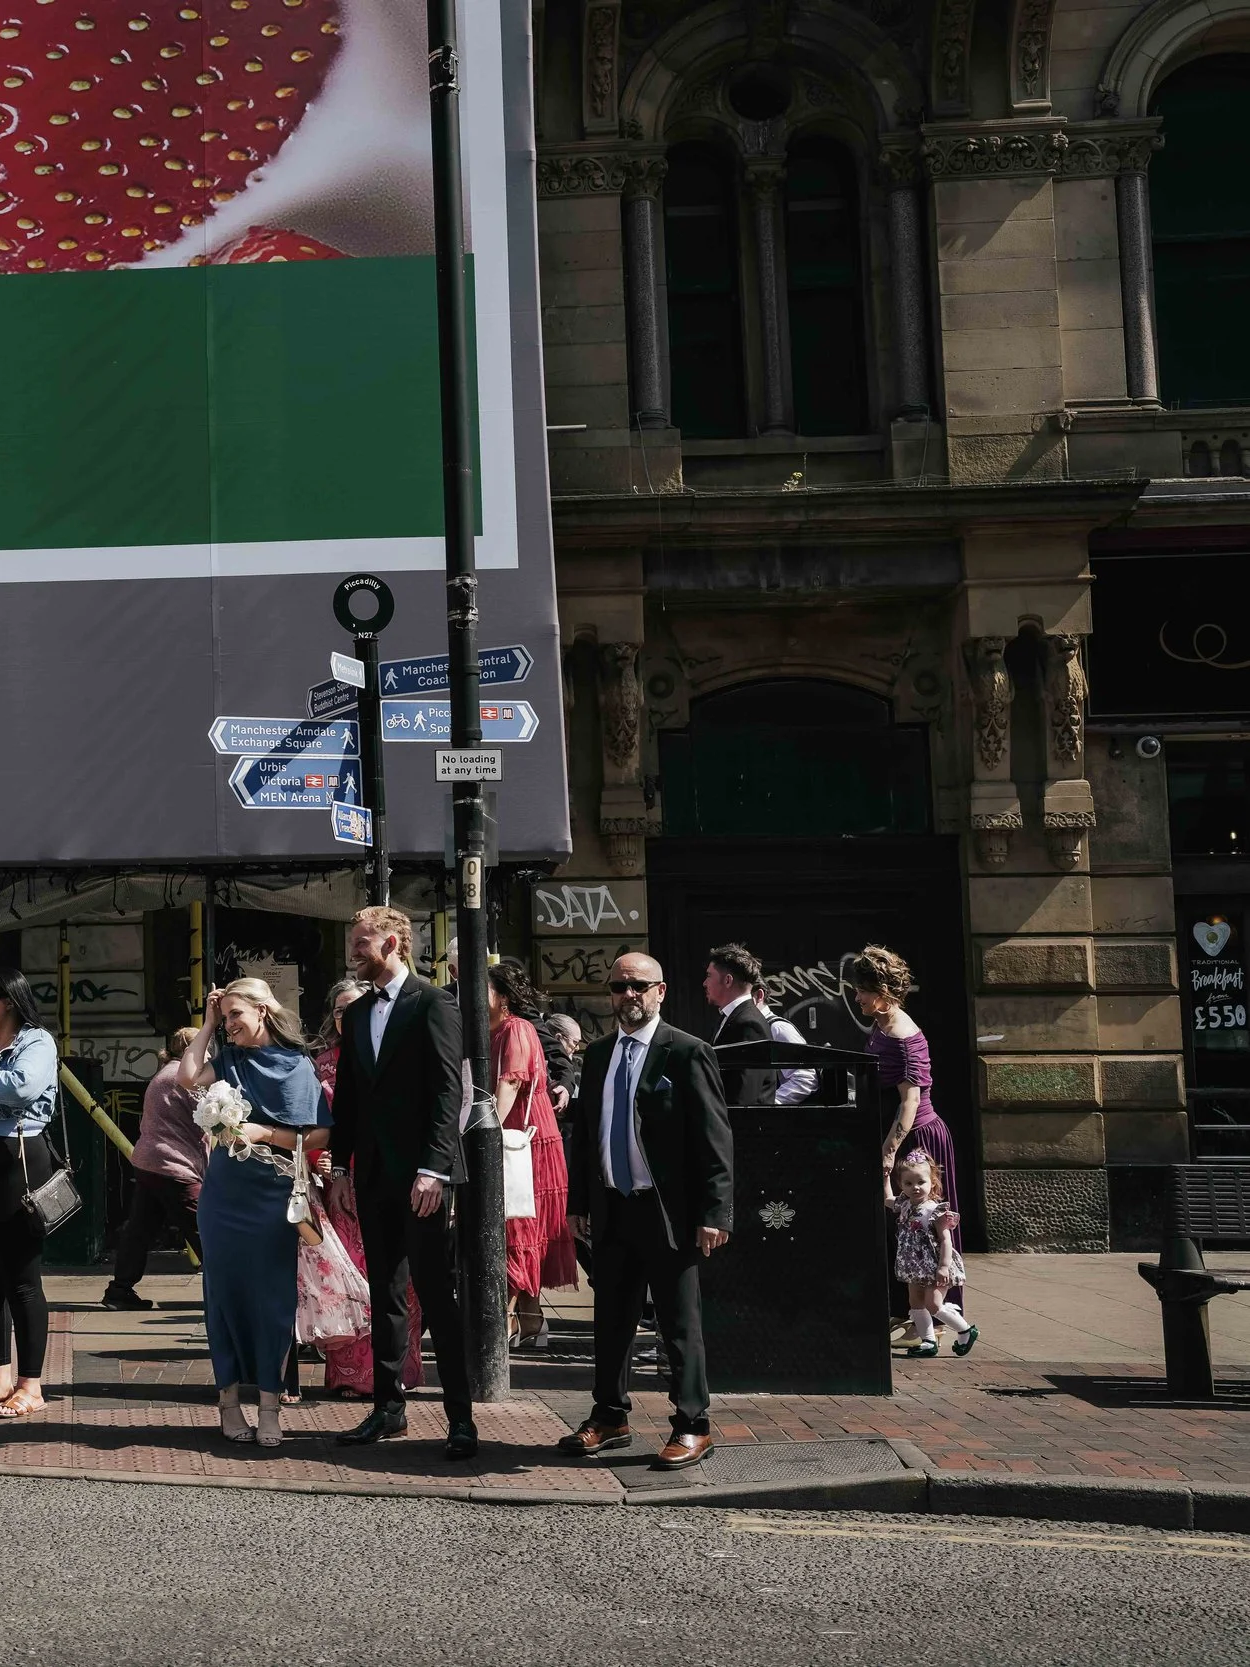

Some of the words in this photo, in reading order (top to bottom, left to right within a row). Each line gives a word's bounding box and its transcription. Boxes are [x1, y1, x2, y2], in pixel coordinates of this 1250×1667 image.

[343, 578, 381, 591] Piccadilly
[402, 663, 449, 676] Manches
[477, 654, 511, 667] entral
[314, 686, 337, 702] Stevenson
[314, 698, 334, 713] Buddhist
[334, 693, 350, 705] Centre
[230, 724, 293, 736] Manchester
[296, 727, 336, 737] Arndale
[231, 737, 281, 748] Exchange
[285, 738, 322, 749] Square
[443, 755, 456, 764] No
[460, 755, 496, 765] loading
[259, 762, 287, 772] Urbis
[454, 767, 472, 776] any
[475, 766, 497, 774] time
[260, 776, 301, 786] Victoria
[260, 793, 287, 802] MEN
[291, 793, 321, 803] Arena
[1191, 967, 1244, 992] Breakfast
[1206, 992, 1230, 1003] from
